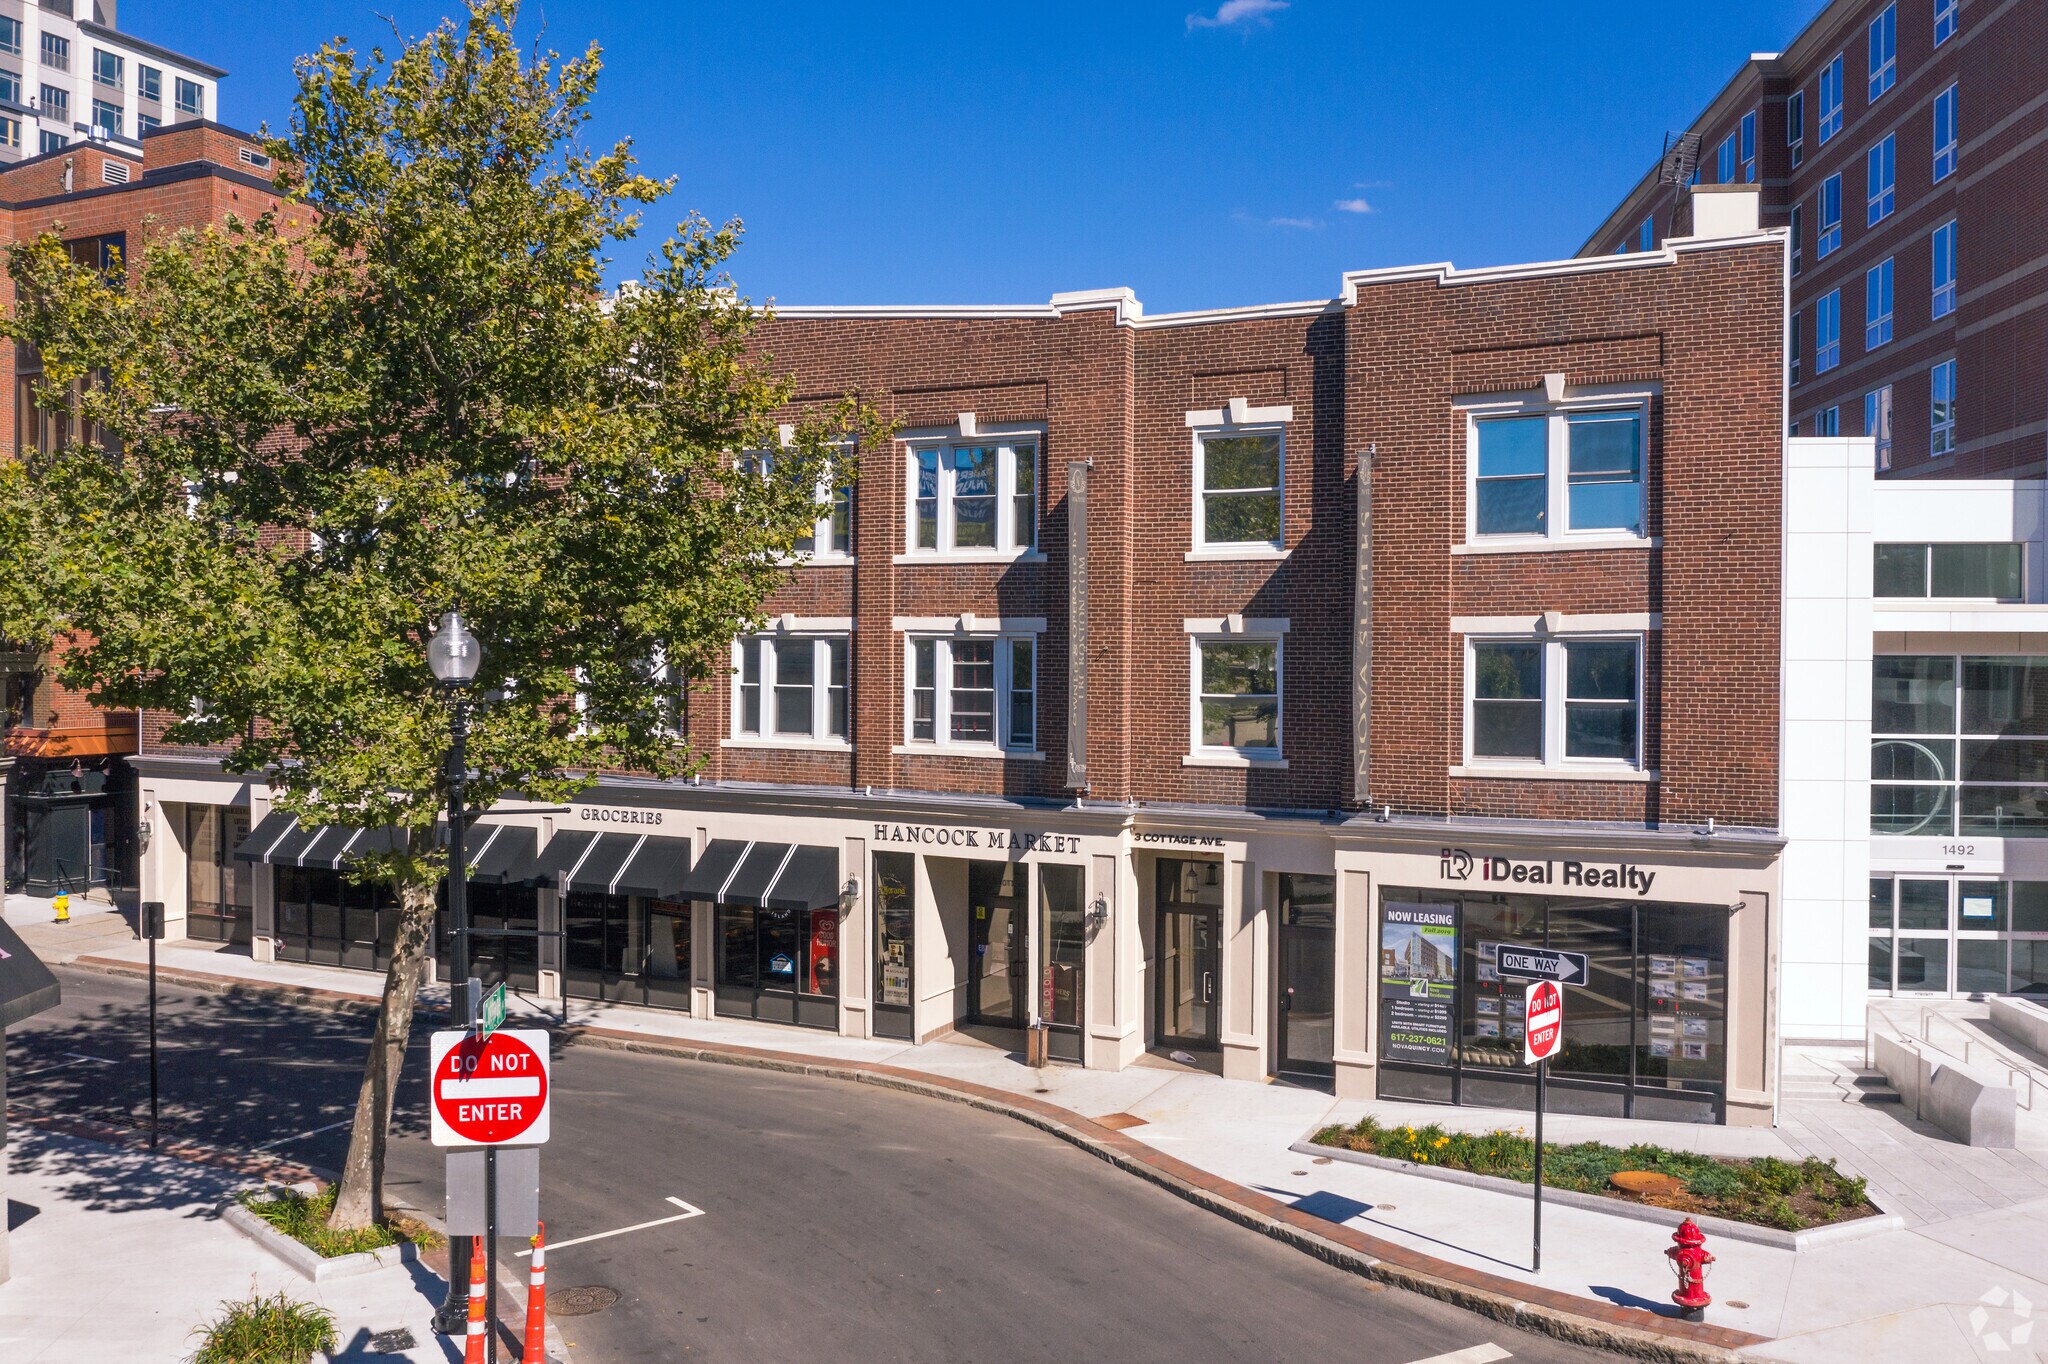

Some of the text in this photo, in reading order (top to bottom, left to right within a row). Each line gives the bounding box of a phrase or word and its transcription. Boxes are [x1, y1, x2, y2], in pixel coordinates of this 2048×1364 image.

[581, 808, 662, 825] GROCERIES
[874, 824, 1081, 854] HANCOCK MARKET
[1134, 832, 1142, 841] 3
[1143, 833, 1197, 846] COTTAGE
[1942, 845, 1975, 856] 1492
[1482, 856, 1656, 896] iDeal Realty
[1388, 911, 1452, 925] NOW LEASING
[1505, 955, 1559, 972] ONE WAY
[1532, 993, 1557, 1013] DO NOT
[1390, 1033, 1447, 1046] 617-237-0621
[1533, 1028, 1554, 1046] ENTER
[1392, 1043, 1446, 1053] NOVAQUINCY.COM
[451, 1053, 530, 1072] DO NOT
[459, 1104, 522, 1122] ENTER
